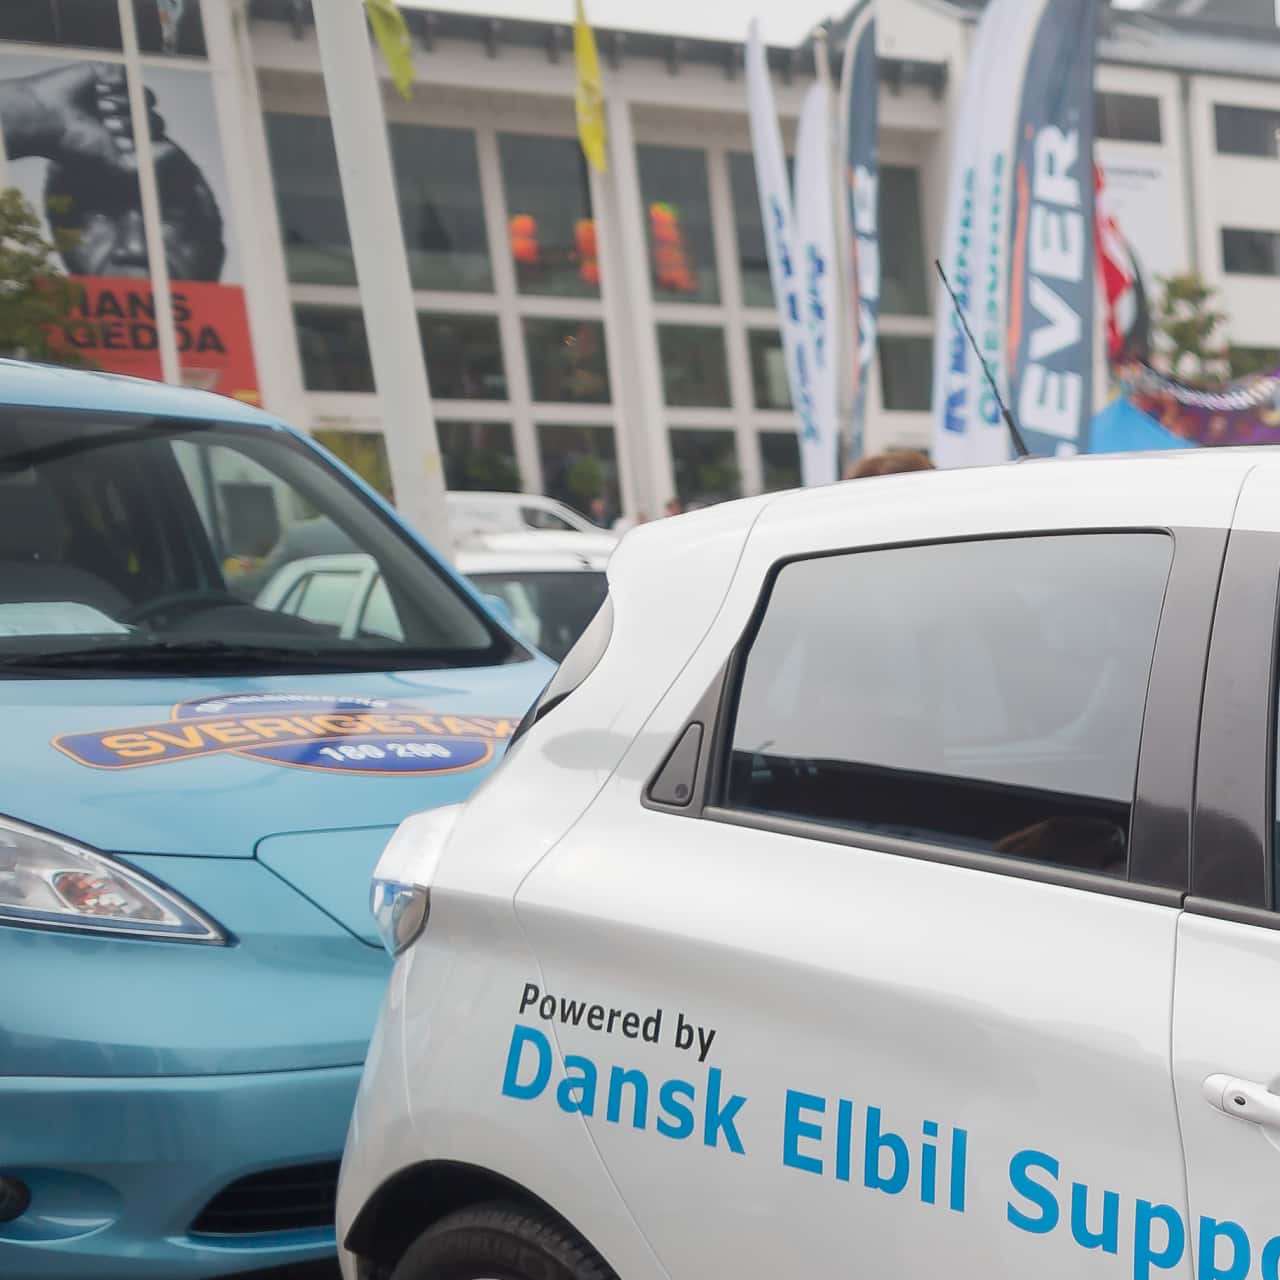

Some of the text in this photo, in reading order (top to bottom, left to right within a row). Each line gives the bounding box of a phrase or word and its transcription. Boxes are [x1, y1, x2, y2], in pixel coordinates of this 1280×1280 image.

[1016, 125, 1084, 457] EVER
[101, 712, 518, 758] SVERIGETAX
[519, 983, 716, 1062] Powered by
[501, 1024, 748, 1155] Dansk
[781, 1089, 969, 1212] Elbil
